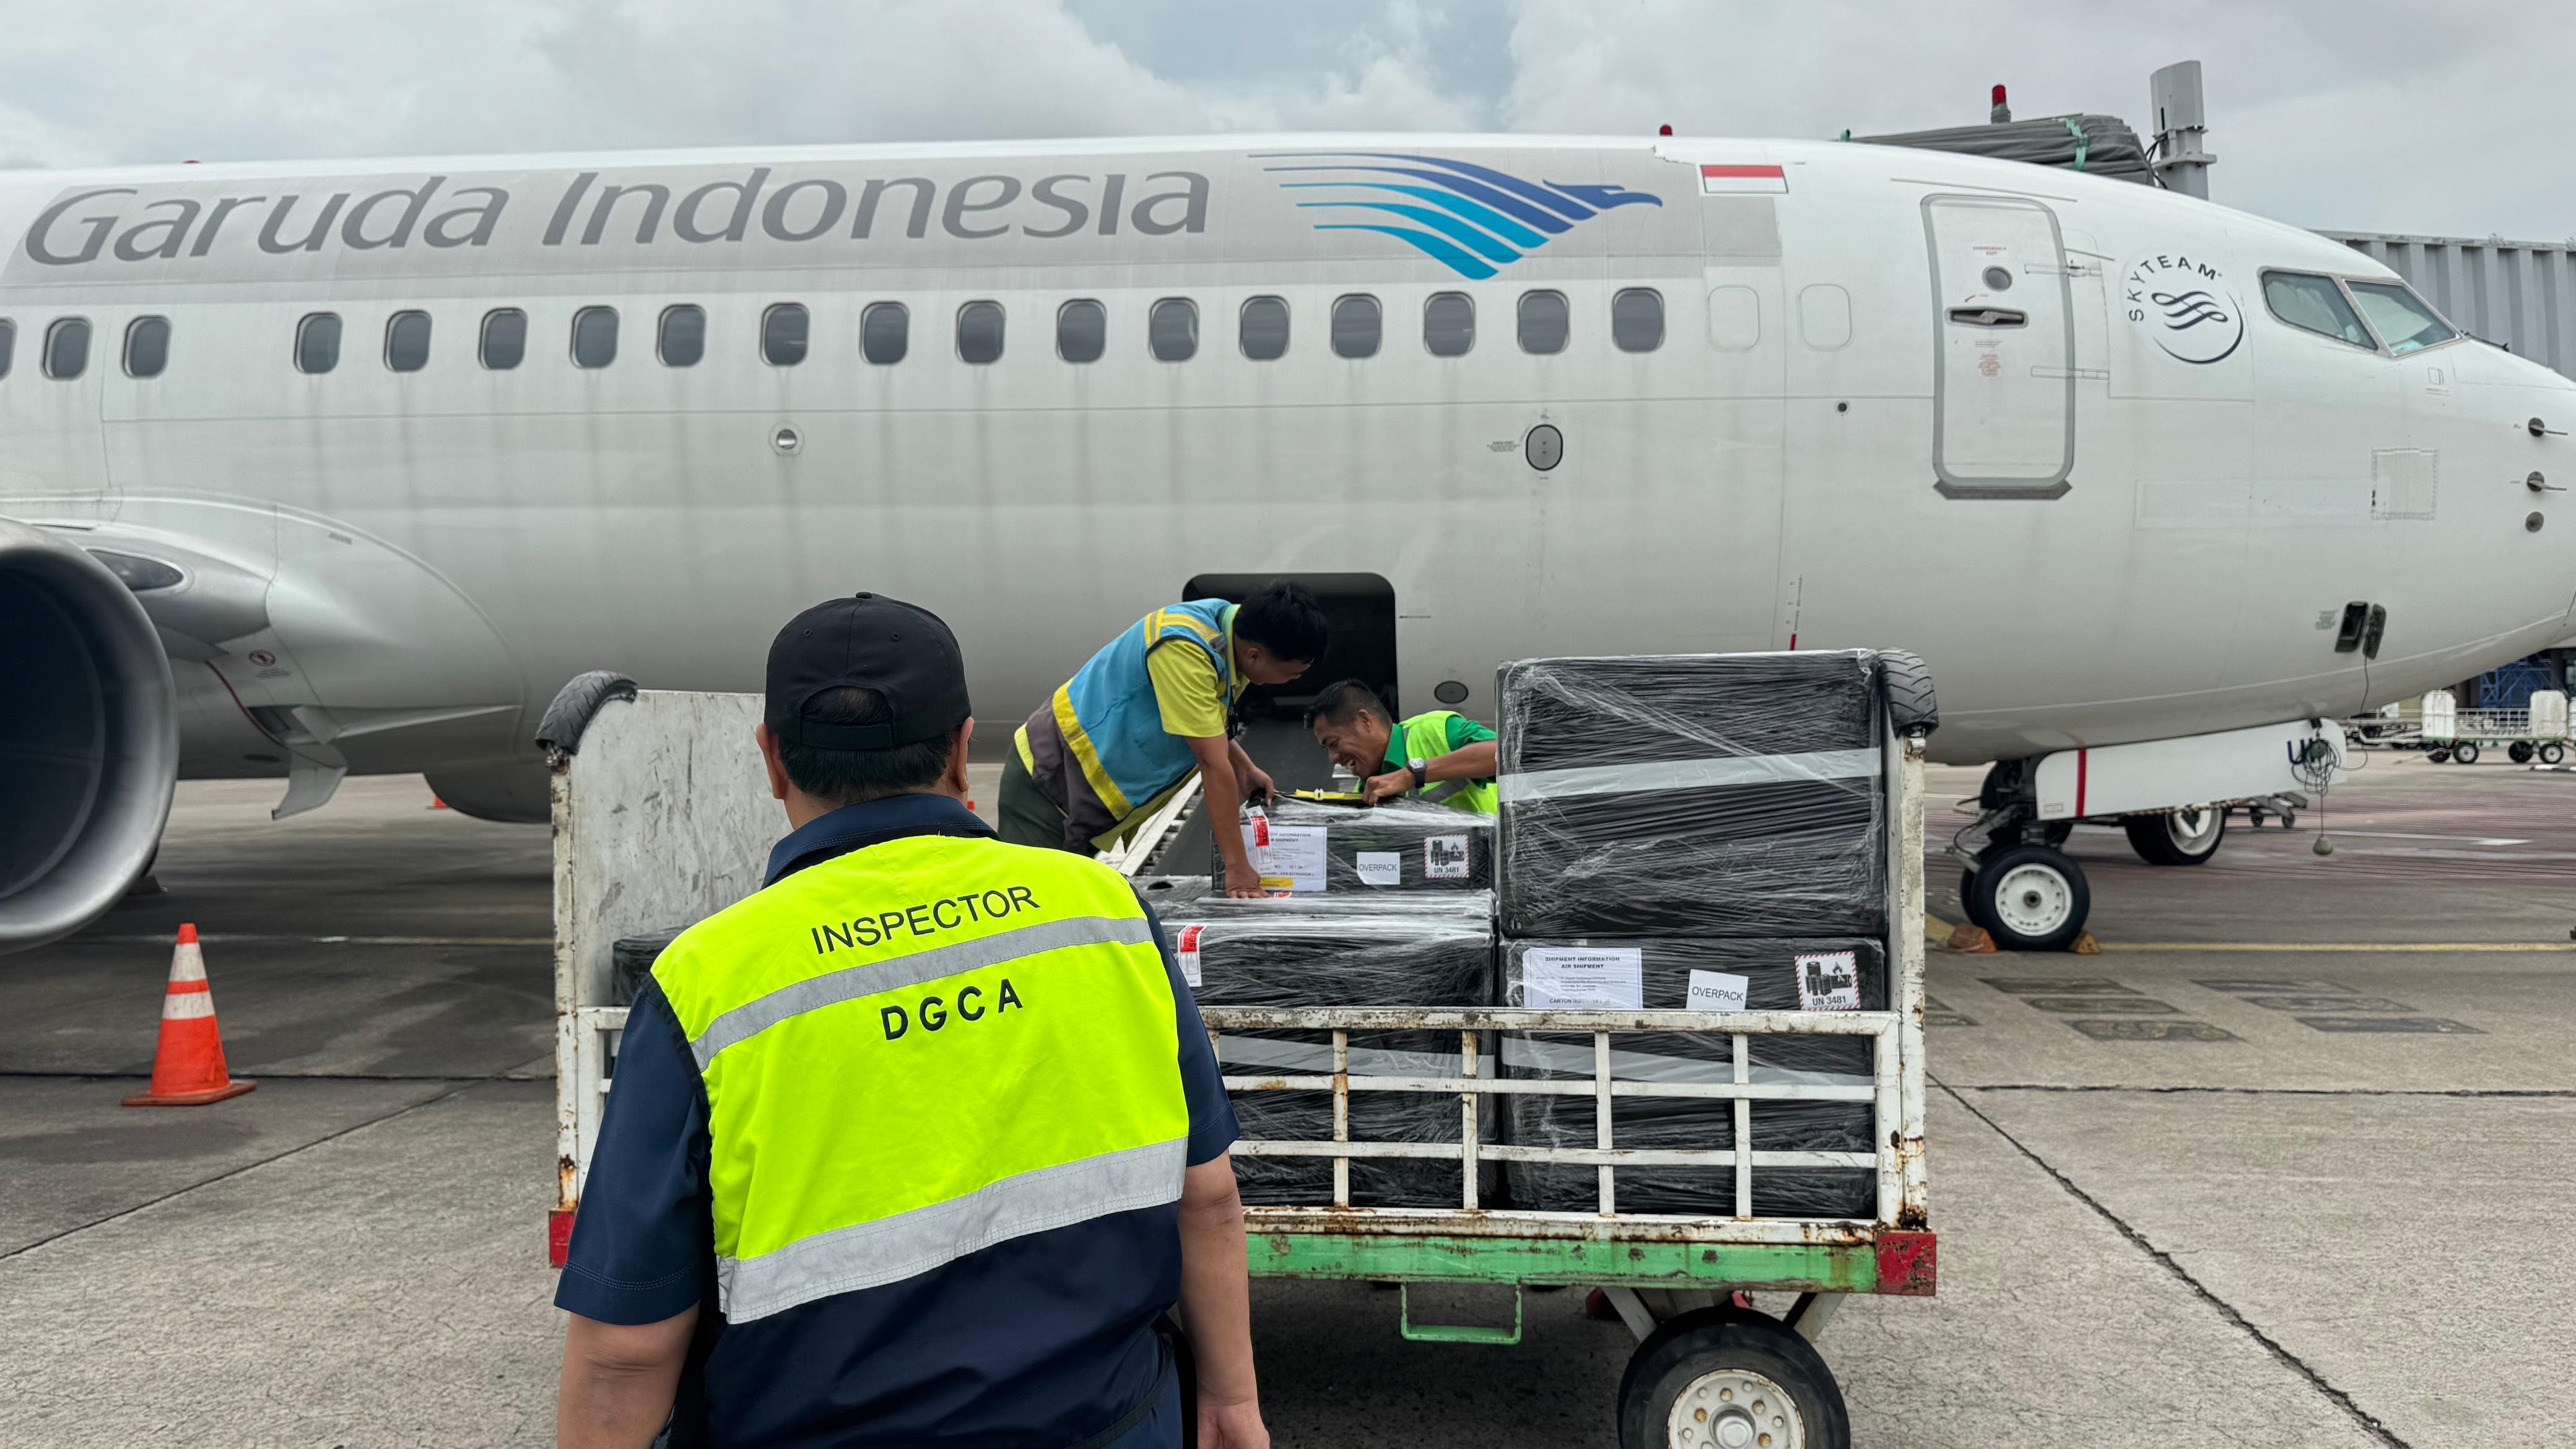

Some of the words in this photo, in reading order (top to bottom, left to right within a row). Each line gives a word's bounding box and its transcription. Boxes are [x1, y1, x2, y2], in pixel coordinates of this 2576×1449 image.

[25, 175, 509, 265] Garuda
[542, 168, 1210, 246] Indonesia
[2127, 255, 2217, 322] SKYTEAM
[1358, 863, 1398, 872] OVERPACK
[811, 886, 1041, 955] INSPECTOR
[881, 978, 1023, 1041] DGCA
[1691, 986, 1744, 1002] OVERPACK
[1812, 997, 1824, 1006] UN
[1827, 995, 1847, 1004] 3481
